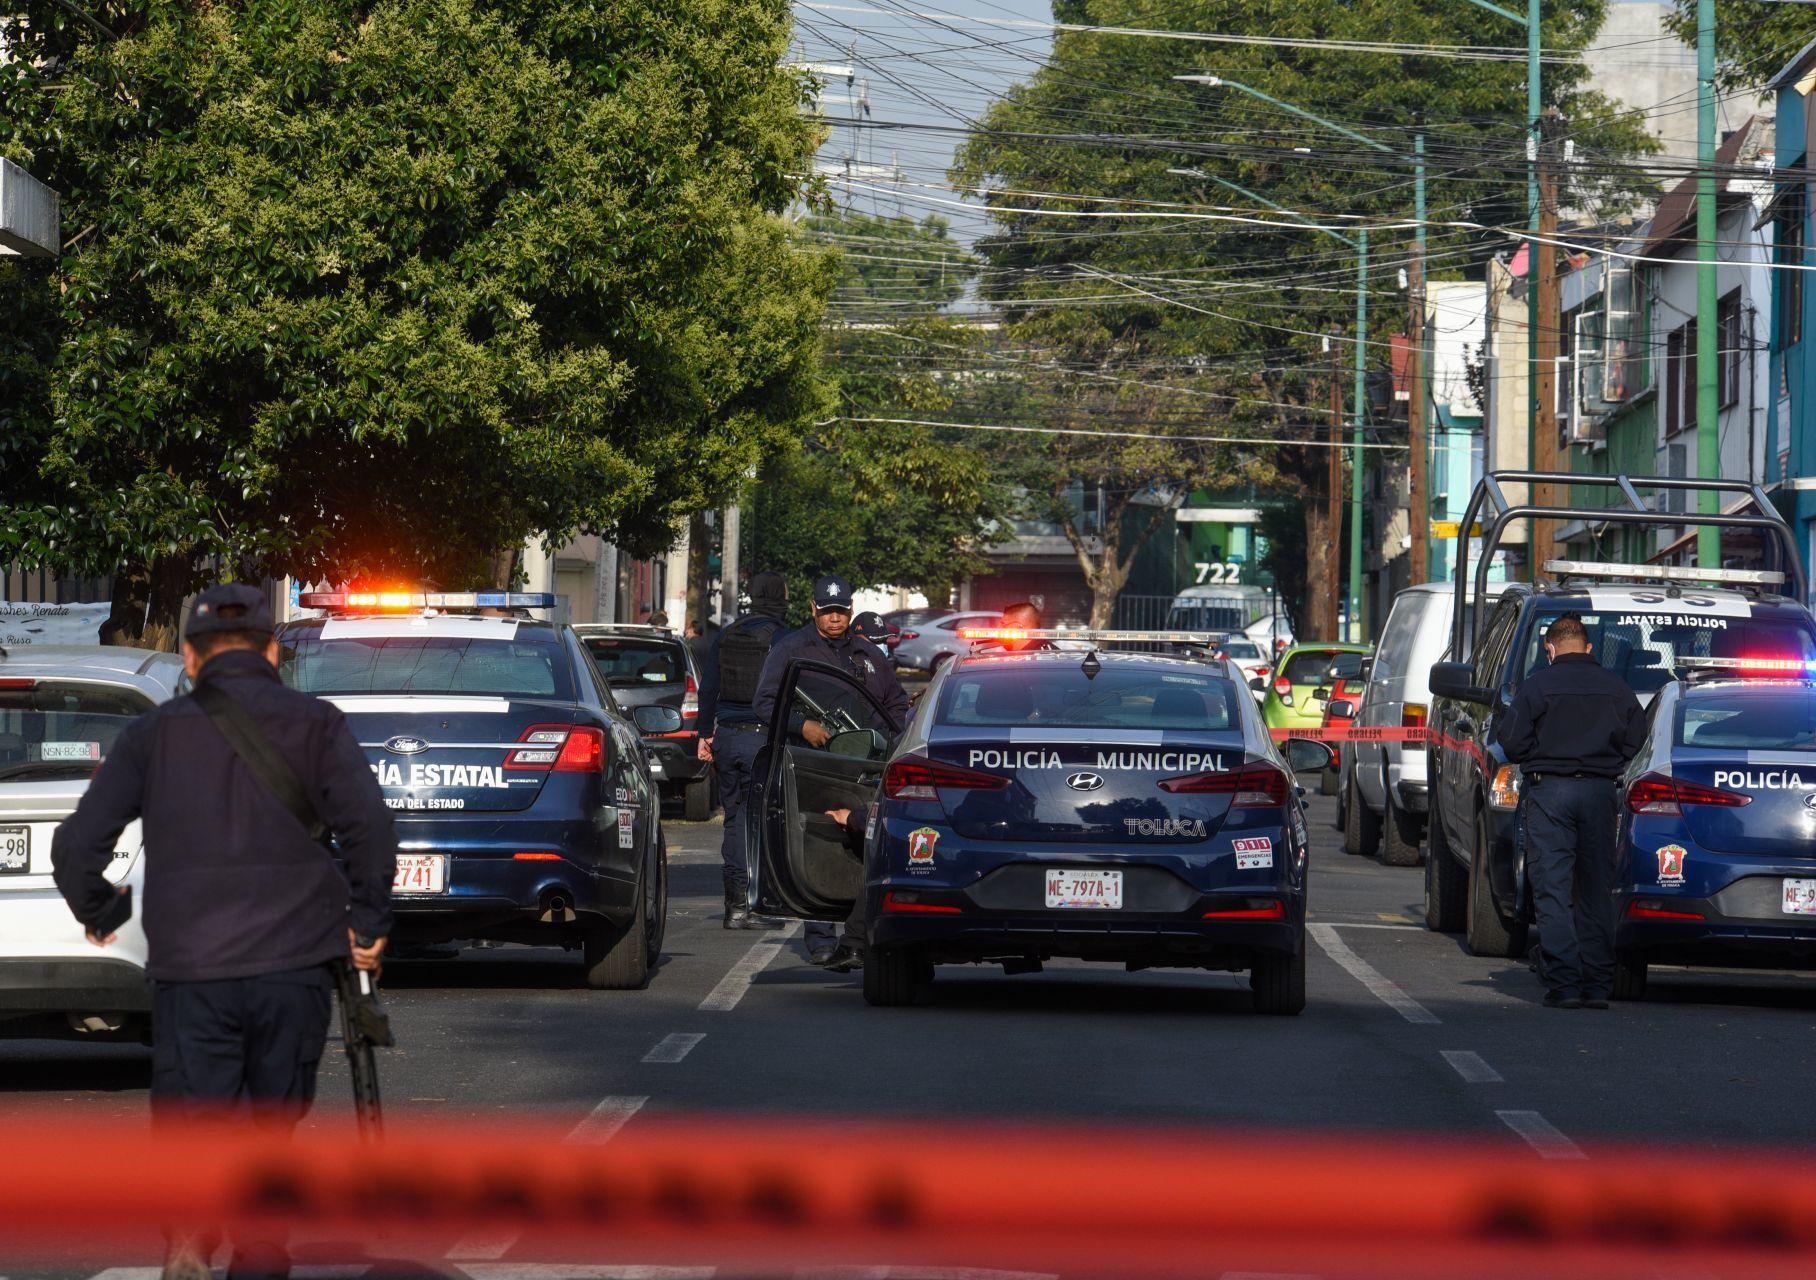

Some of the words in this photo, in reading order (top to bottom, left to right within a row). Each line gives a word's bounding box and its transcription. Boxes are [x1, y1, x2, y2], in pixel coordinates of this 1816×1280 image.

[1194, 562, 1240, 584] 722
[31, 604, 71, 616] Renata
[7, 635, 32, 645] Rusa
[43, 746, 91, 757] NSN-82-98
[394, 739, 419, 750] Ford
[969, 748, 1063, 769] POLICÍA
[1097, 752, 1229, 772] MUNICIPAL
[410, 764, 509, 788] ESTATAL
[1714, 770, 1803, 789] POLICÍA
[385, 799, 405, 809] RZA
[407, 798, 426, 809] DEL
[428, 799, 465, 809] ESTADO
[1123, 818, 1207, 837] TOLUCA
[1236, 840, 1268, 850] 911
[1048, 879, 1119, 897] ME-797A-1
